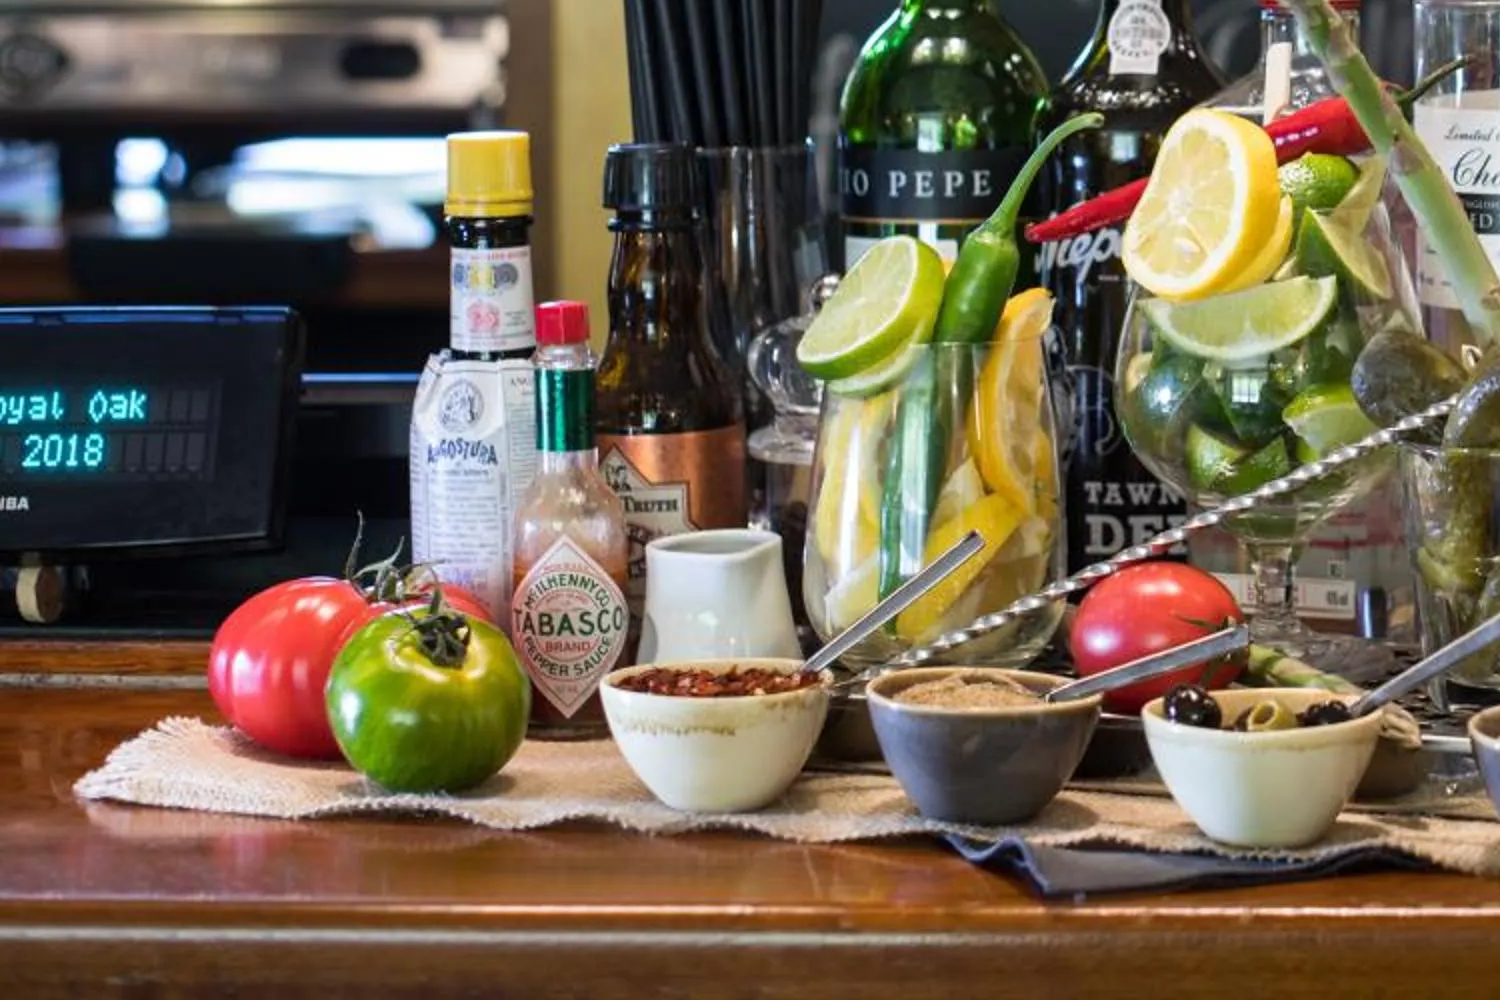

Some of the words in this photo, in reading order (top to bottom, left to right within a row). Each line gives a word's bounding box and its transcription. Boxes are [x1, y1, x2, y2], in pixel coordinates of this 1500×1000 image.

[888, 169, 992, 198] PEPE
[89, 390, 147, 423] Oak
[22, 434, 104, 467] 2018
[1083, 481, 1182, 505] TAWN
[513, 605, 623, 637] TABASCO
[525, 636, 569, 677] PEPPER
[574, 636, 610, 677] SAUCE
[545, 641, 591, 653] BRAND
